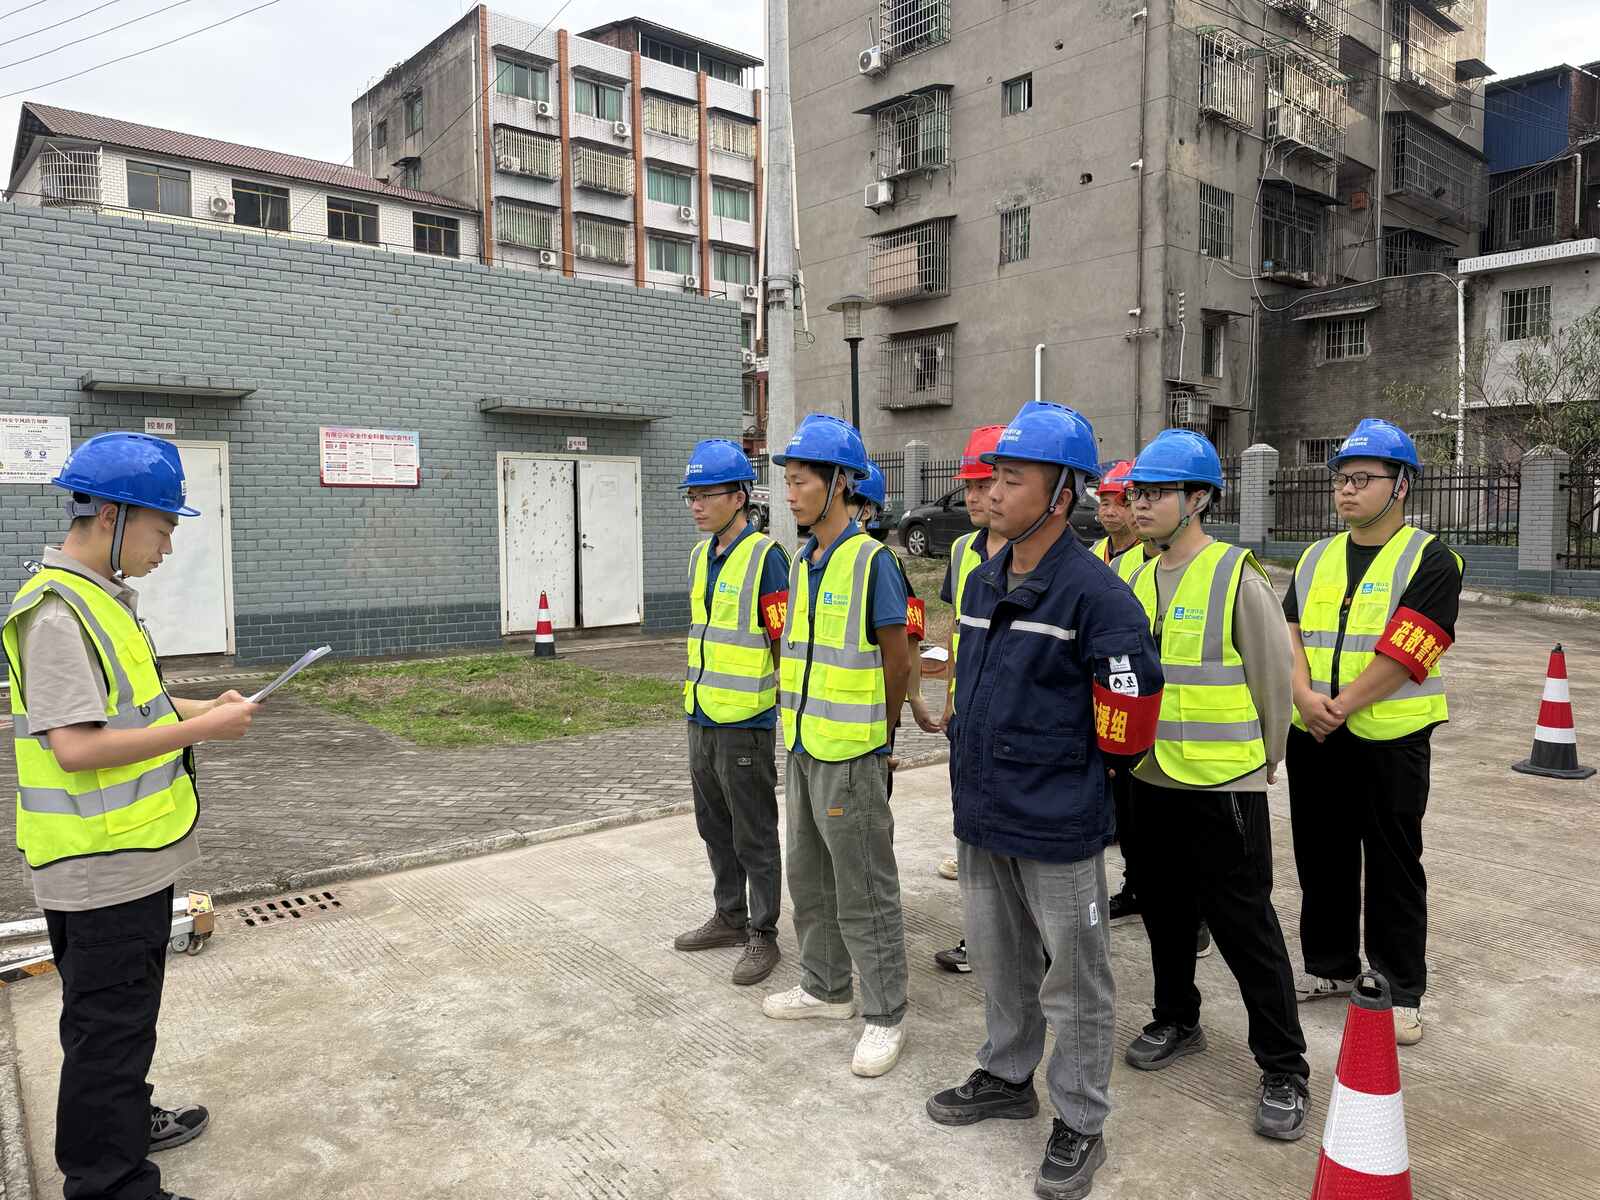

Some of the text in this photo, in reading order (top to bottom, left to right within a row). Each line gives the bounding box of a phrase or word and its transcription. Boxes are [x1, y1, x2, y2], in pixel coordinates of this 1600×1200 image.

[147, 422, 173, 431] 控制房
[1092, 697, 1128, 743] 援组
